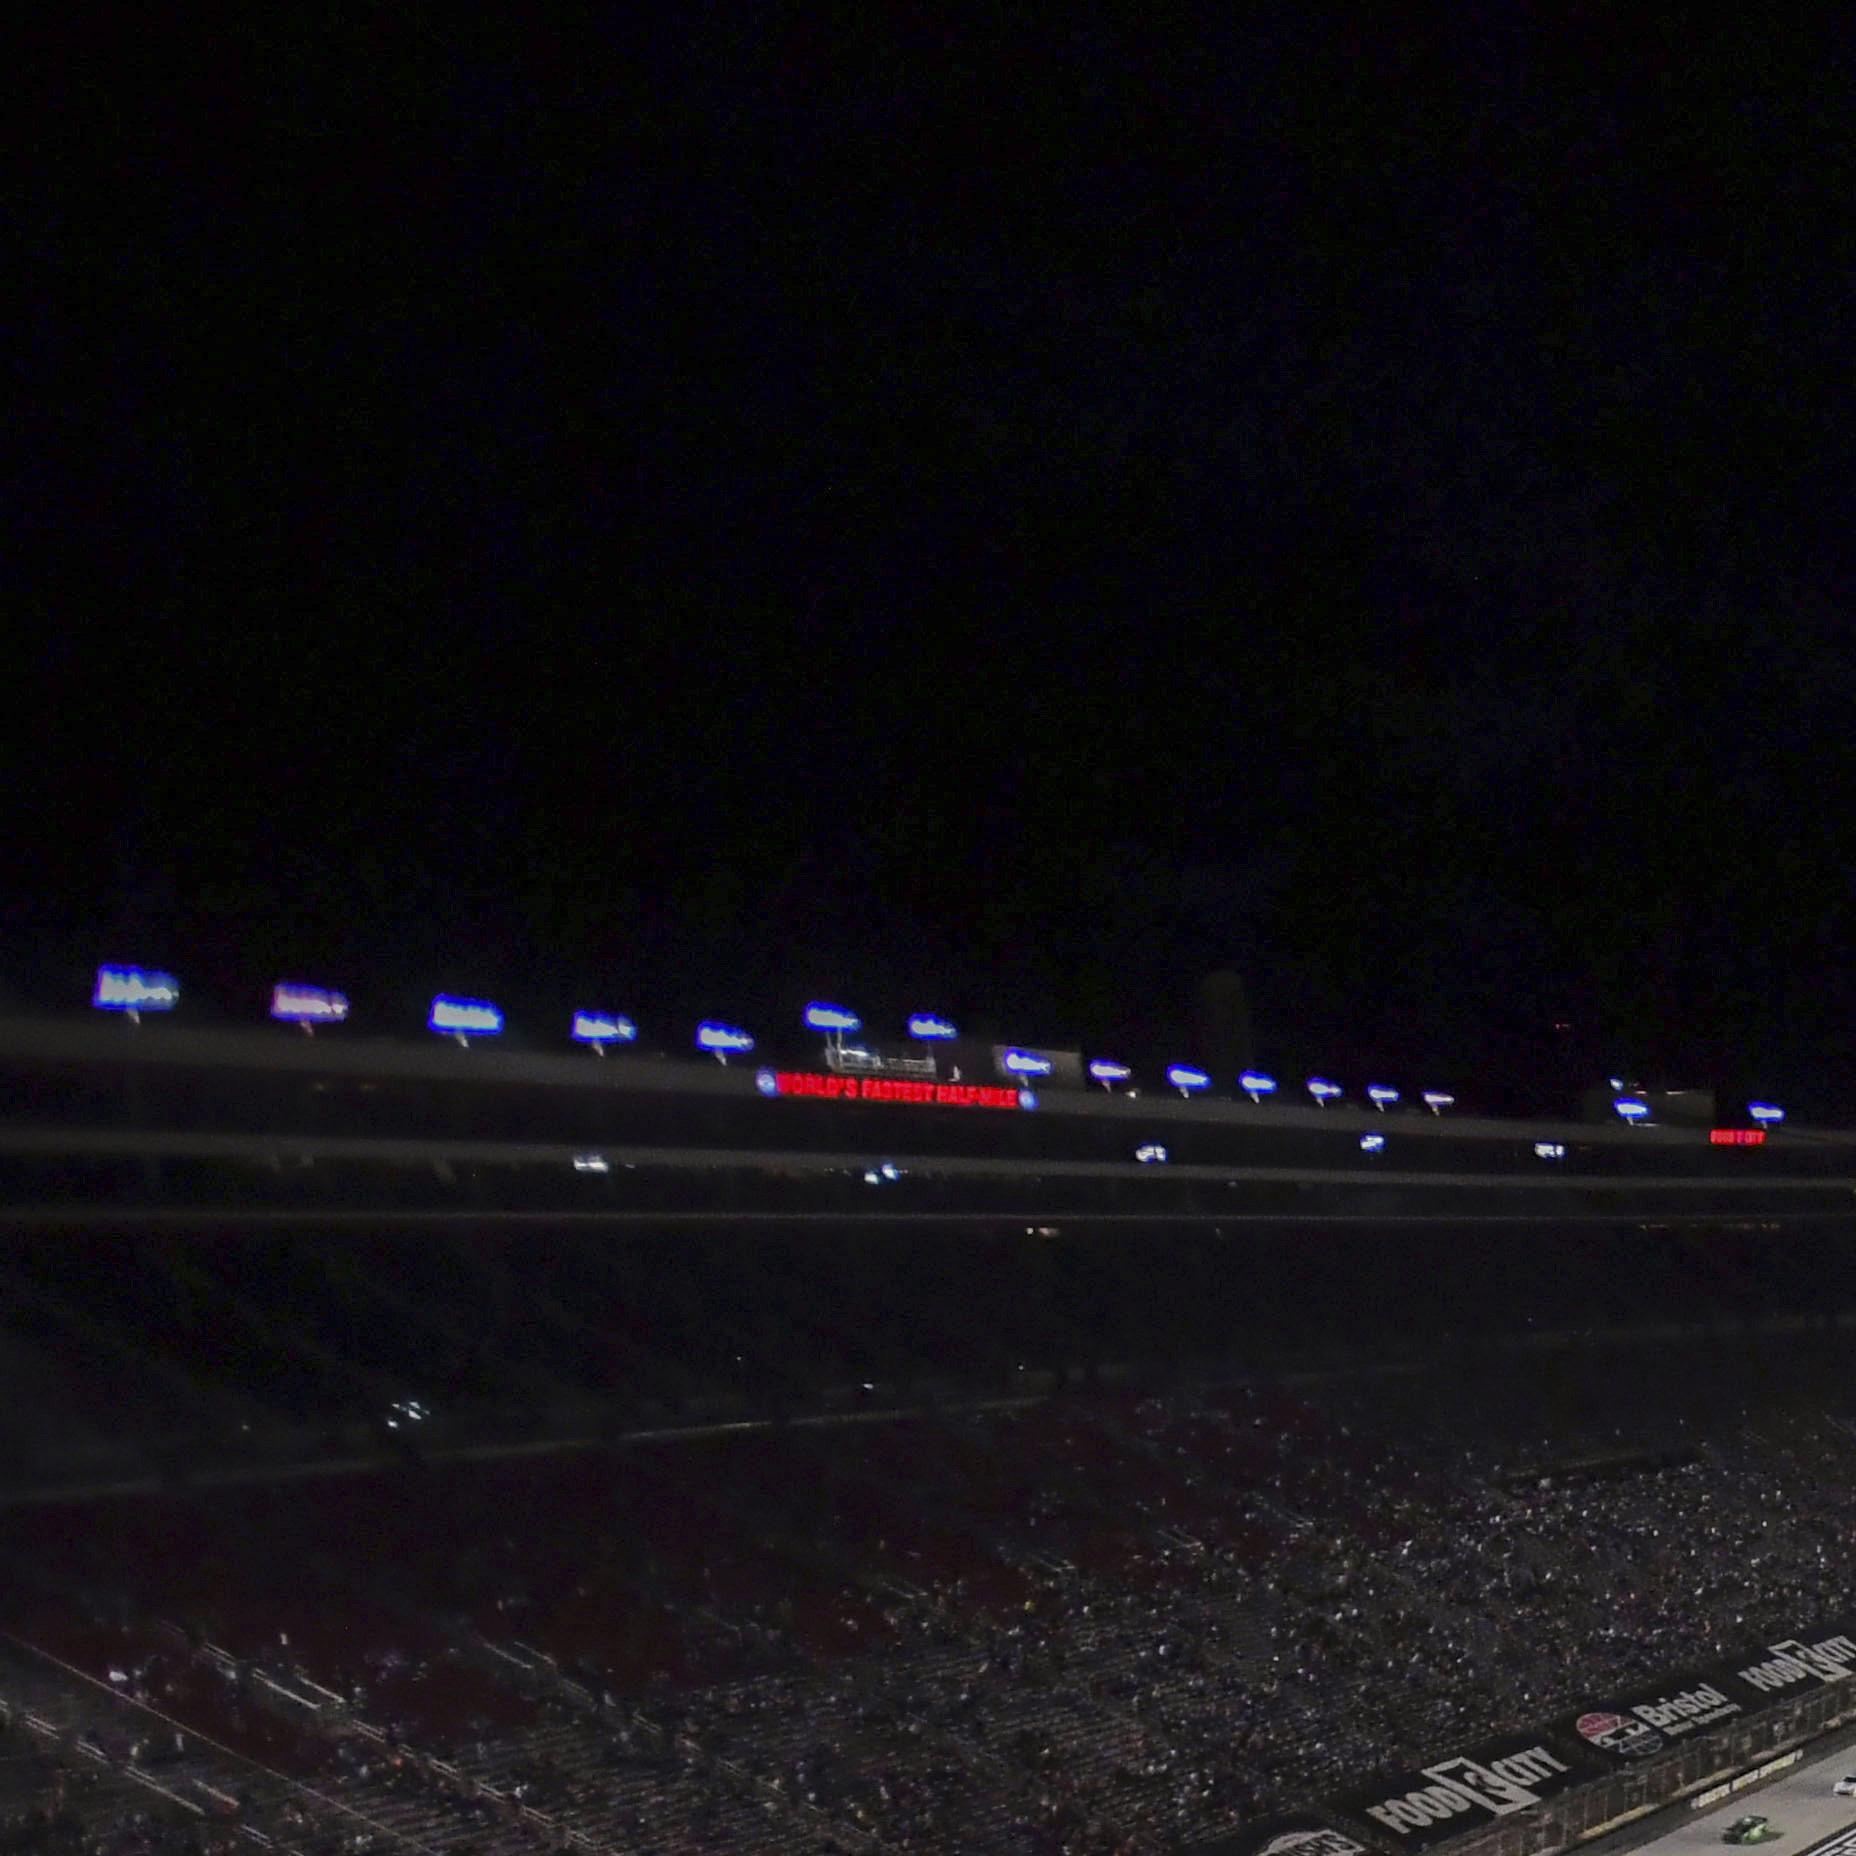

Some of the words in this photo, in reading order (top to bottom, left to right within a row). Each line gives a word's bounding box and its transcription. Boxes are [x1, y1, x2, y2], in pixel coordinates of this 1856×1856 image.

[861, 1077, 934, 1102] FASTEST
[1738, 1660, 1808, 1692] FOOD
[1632, 1682, 1728, 1728] Bristol
[1365, 1786, 1476, 1834] FOOD
[1492, 1745, 1573, 1790] CITY
